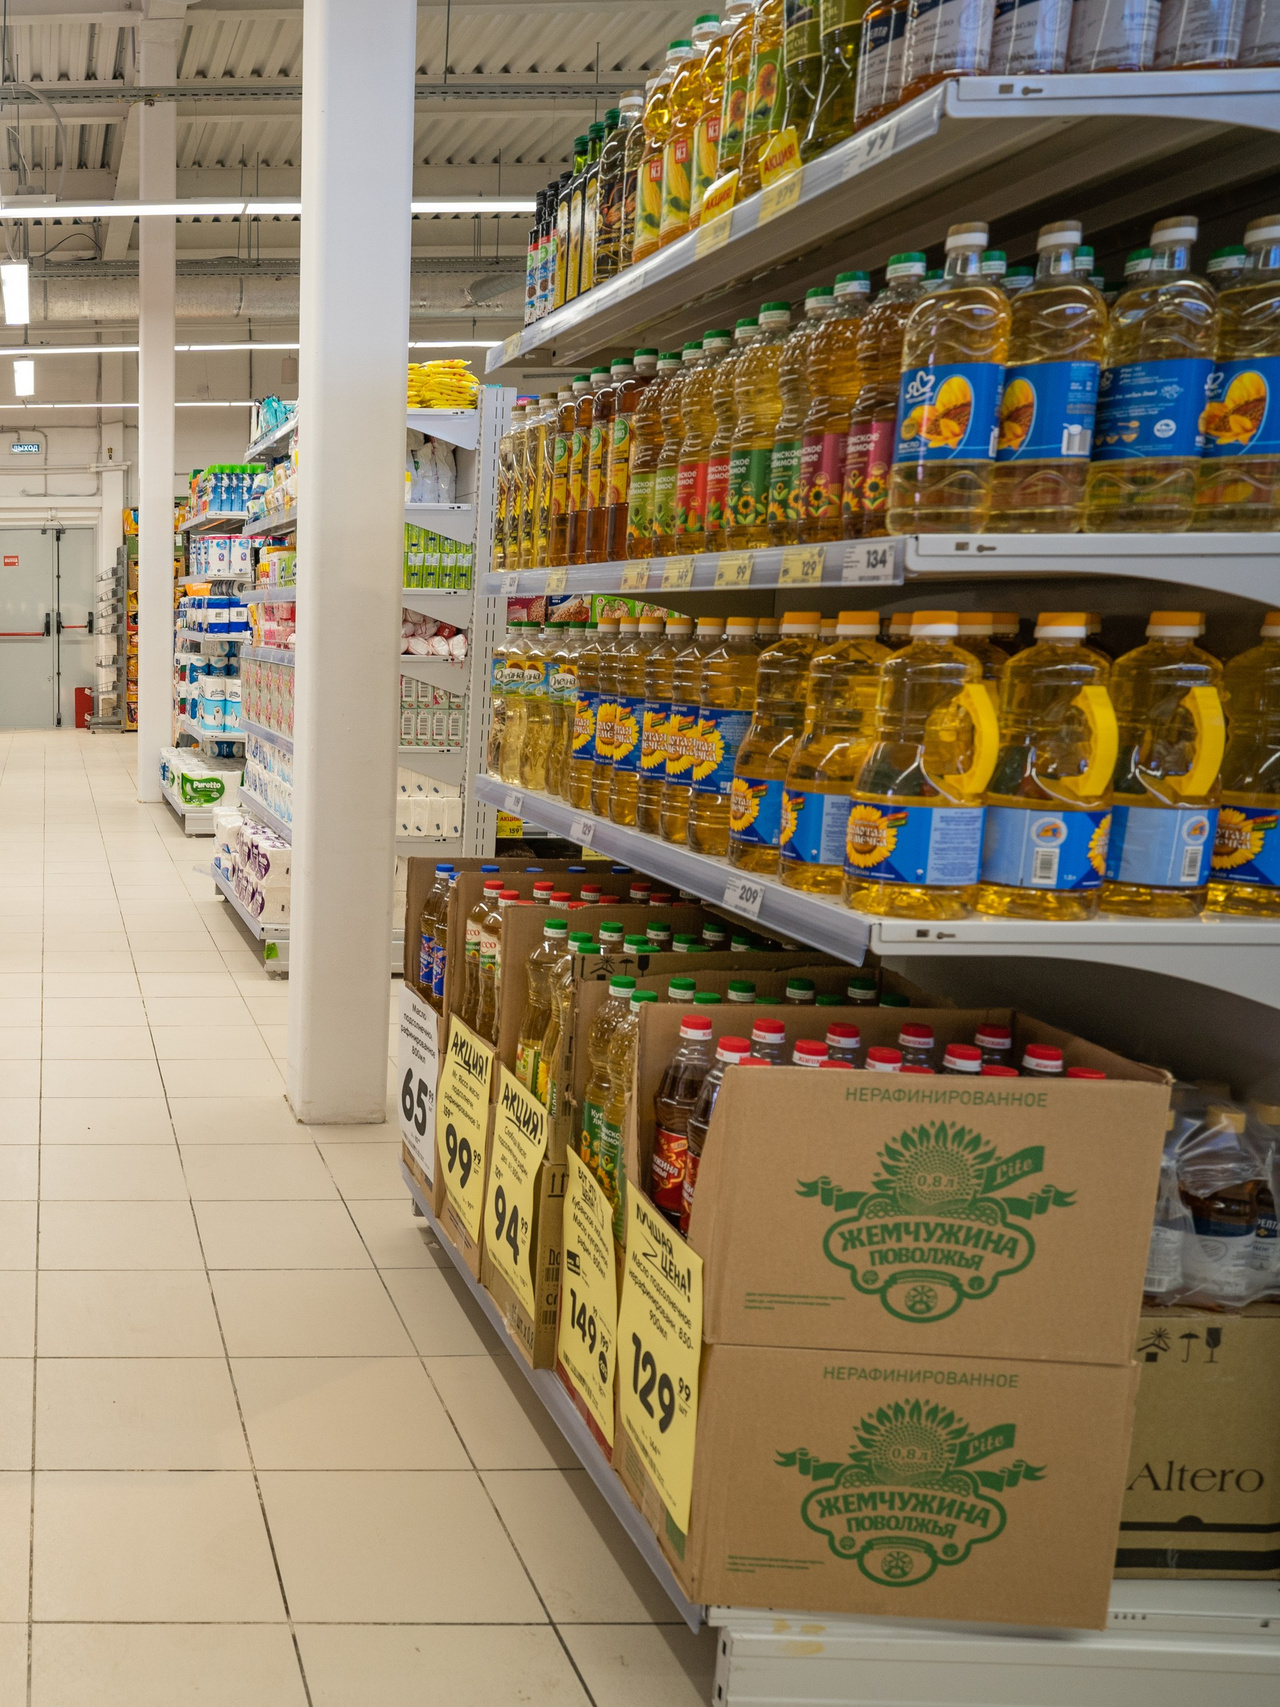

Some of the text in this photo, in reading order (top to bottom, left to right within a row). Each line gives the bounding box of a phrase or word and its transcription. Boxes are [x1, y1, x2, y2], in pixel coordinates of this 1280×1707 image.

[764, 145, 796, 172] АКЦИЯ!
[703, 186, 733, 214] АКЦИЯ!
[866, 550, 887, 569] 134
[193, 780, 221, 789] Puretto
[739, 885, 758, 905] 209
[451, 1031, 489, 1084] АКЦИЯ!
[402, 1067, 428, 1136] 65
[845, 1087, 1048, 1108] НЕРАФИНИРОВАННОЕ
[501, 1082, 543, 1145] АКЦИЯ!
[446, 1123, 472, 1188] 99
[473, 1149, 481, 1165] 99
[917, 1173, 942, 1190] 0,8
[992, 1158, 1033, 1186] Lite
[494, 1185, 519, 1266] 94
[636, 1203, 674, 1260] ЛУЧШАЯ
[837, 1221, 1019, 1260] ЖЕМЧУЖИНА
[869, 1248, 984, 1272] ПОВОЛЖЬЯ
[661, 1250, 692, 1304] ЦЕНА!
[570, 1288, 596, 1355] 149
[631, 1332, 676, 1435] 129
[678, 1376, 692, 1402] 99
[823, 1366, 1019, 1388] НЕРАФИНИРОВАННОЕ
[891, 1446, 918, 1462] 0,8
[965, 1434, 1005, 1460] Lite
[1126, 1460, 1265, 1494] Altero
[816, 1490, 991, 1530] ЖЕМЧУЖИНА
[846, 1515, 957, 1540] ПОВОЛЖЬЯ
